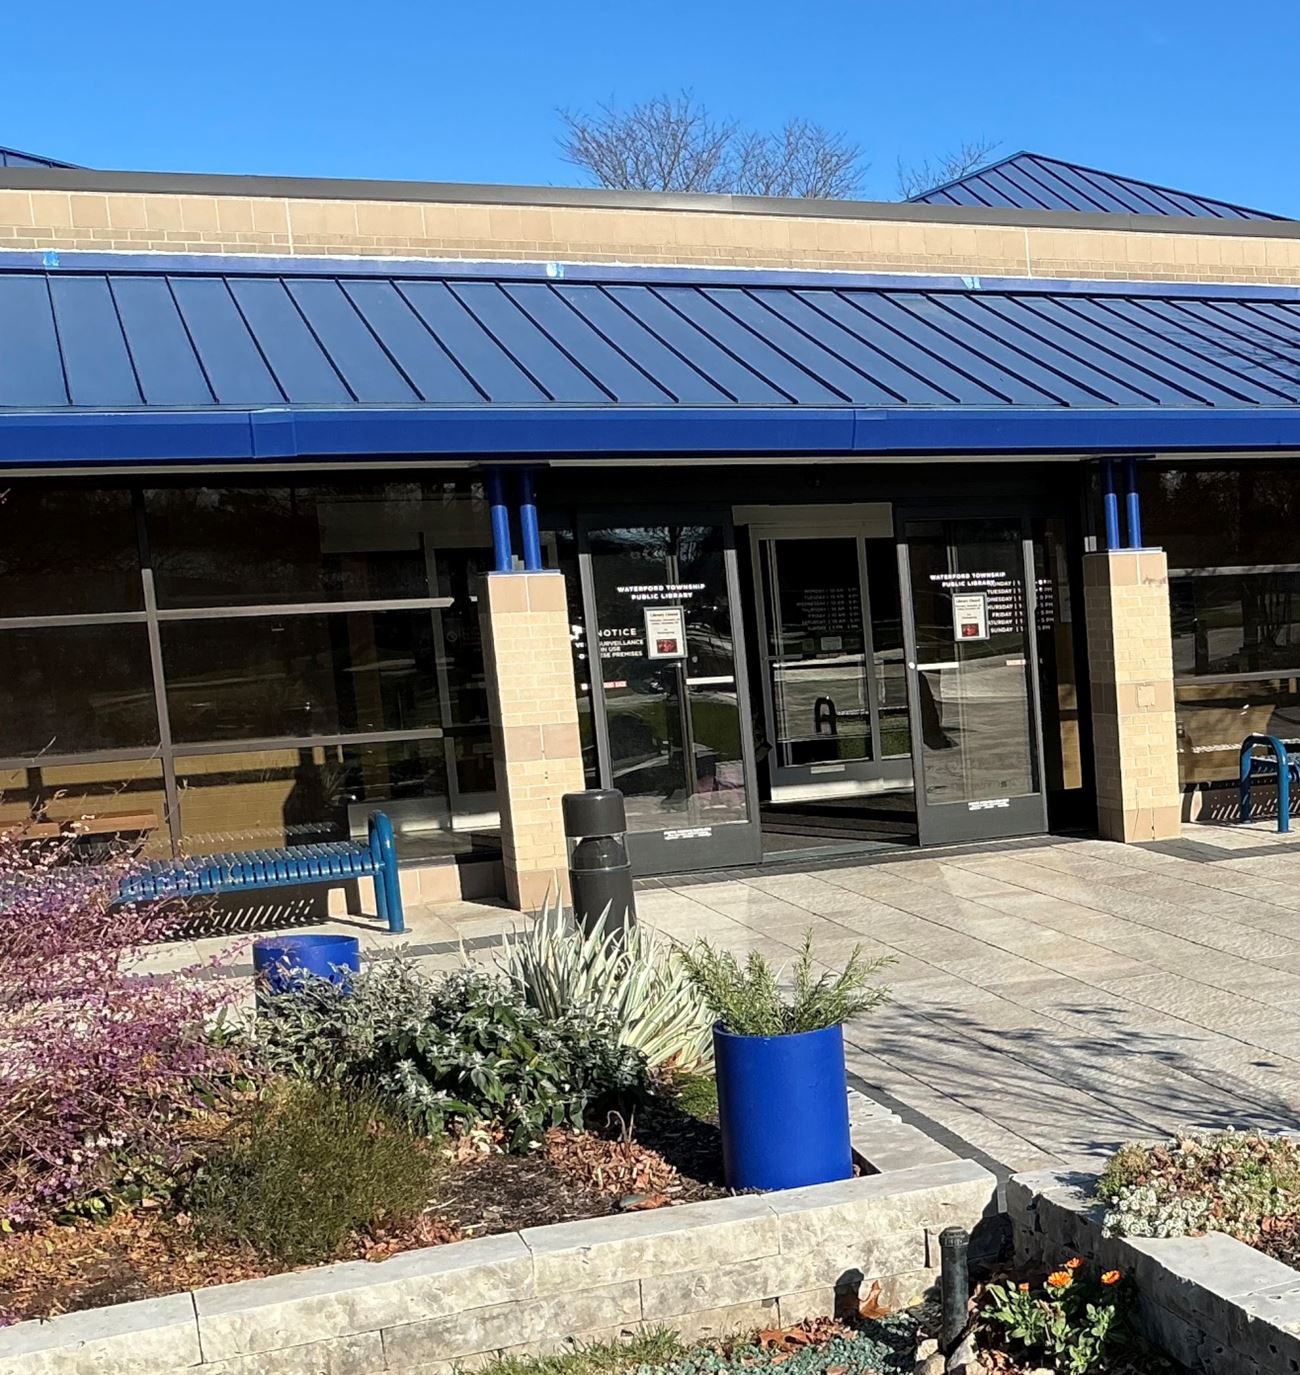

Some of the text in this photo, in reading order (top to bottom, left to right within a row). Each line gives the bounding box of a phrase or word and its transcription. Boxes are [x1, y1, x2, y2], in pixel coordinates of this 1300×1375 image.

[617, 583, 706, 593] WATERFORD TOWNSHIP
[598, 628, 637, 637] NOTICE
[600, 639, 644, 647] URVEILLANCE
